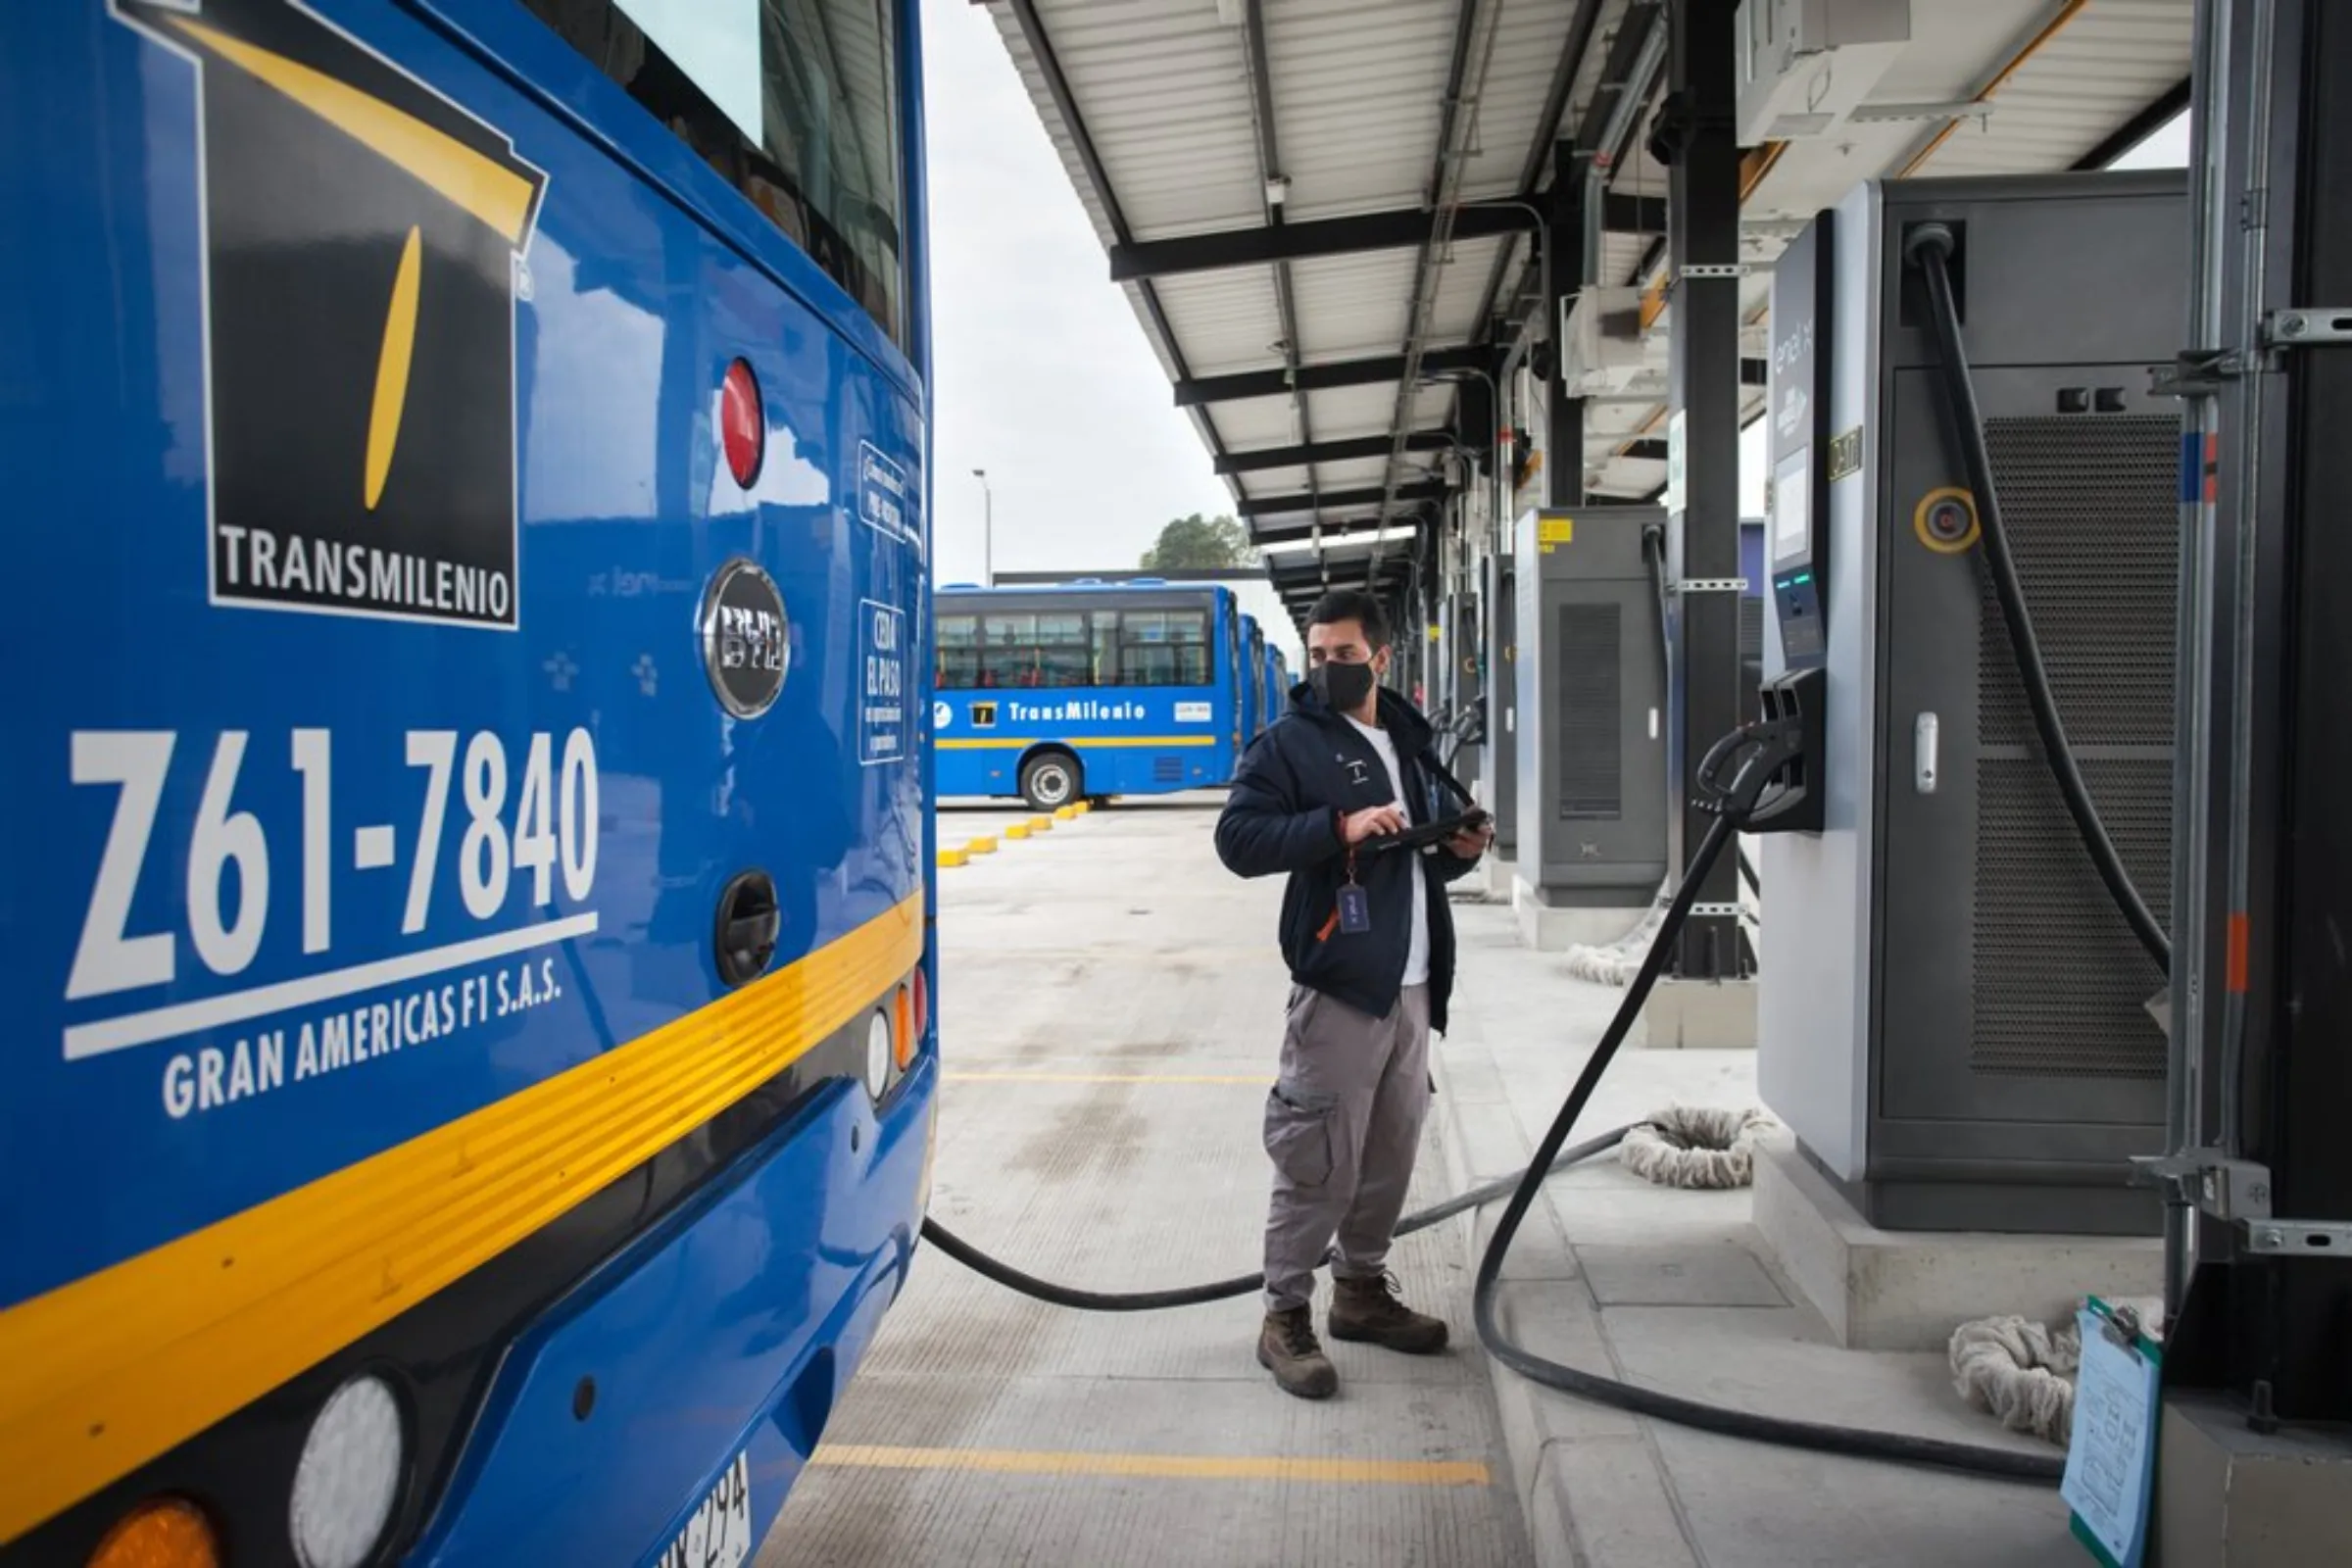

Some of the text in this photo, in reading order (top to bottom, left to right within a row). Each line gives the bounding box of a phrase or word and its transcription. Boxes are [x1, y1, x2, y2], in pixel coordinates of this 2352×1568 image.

[218, 525, 509, 616] TRANSMILENIO
[1009, 702, 1146, 720] TransMilenio
[65, 727, 598, 1000] Z61-7840
[163, 958, 562, 1118] GRAN AMERICAS F1 S.A.S.
